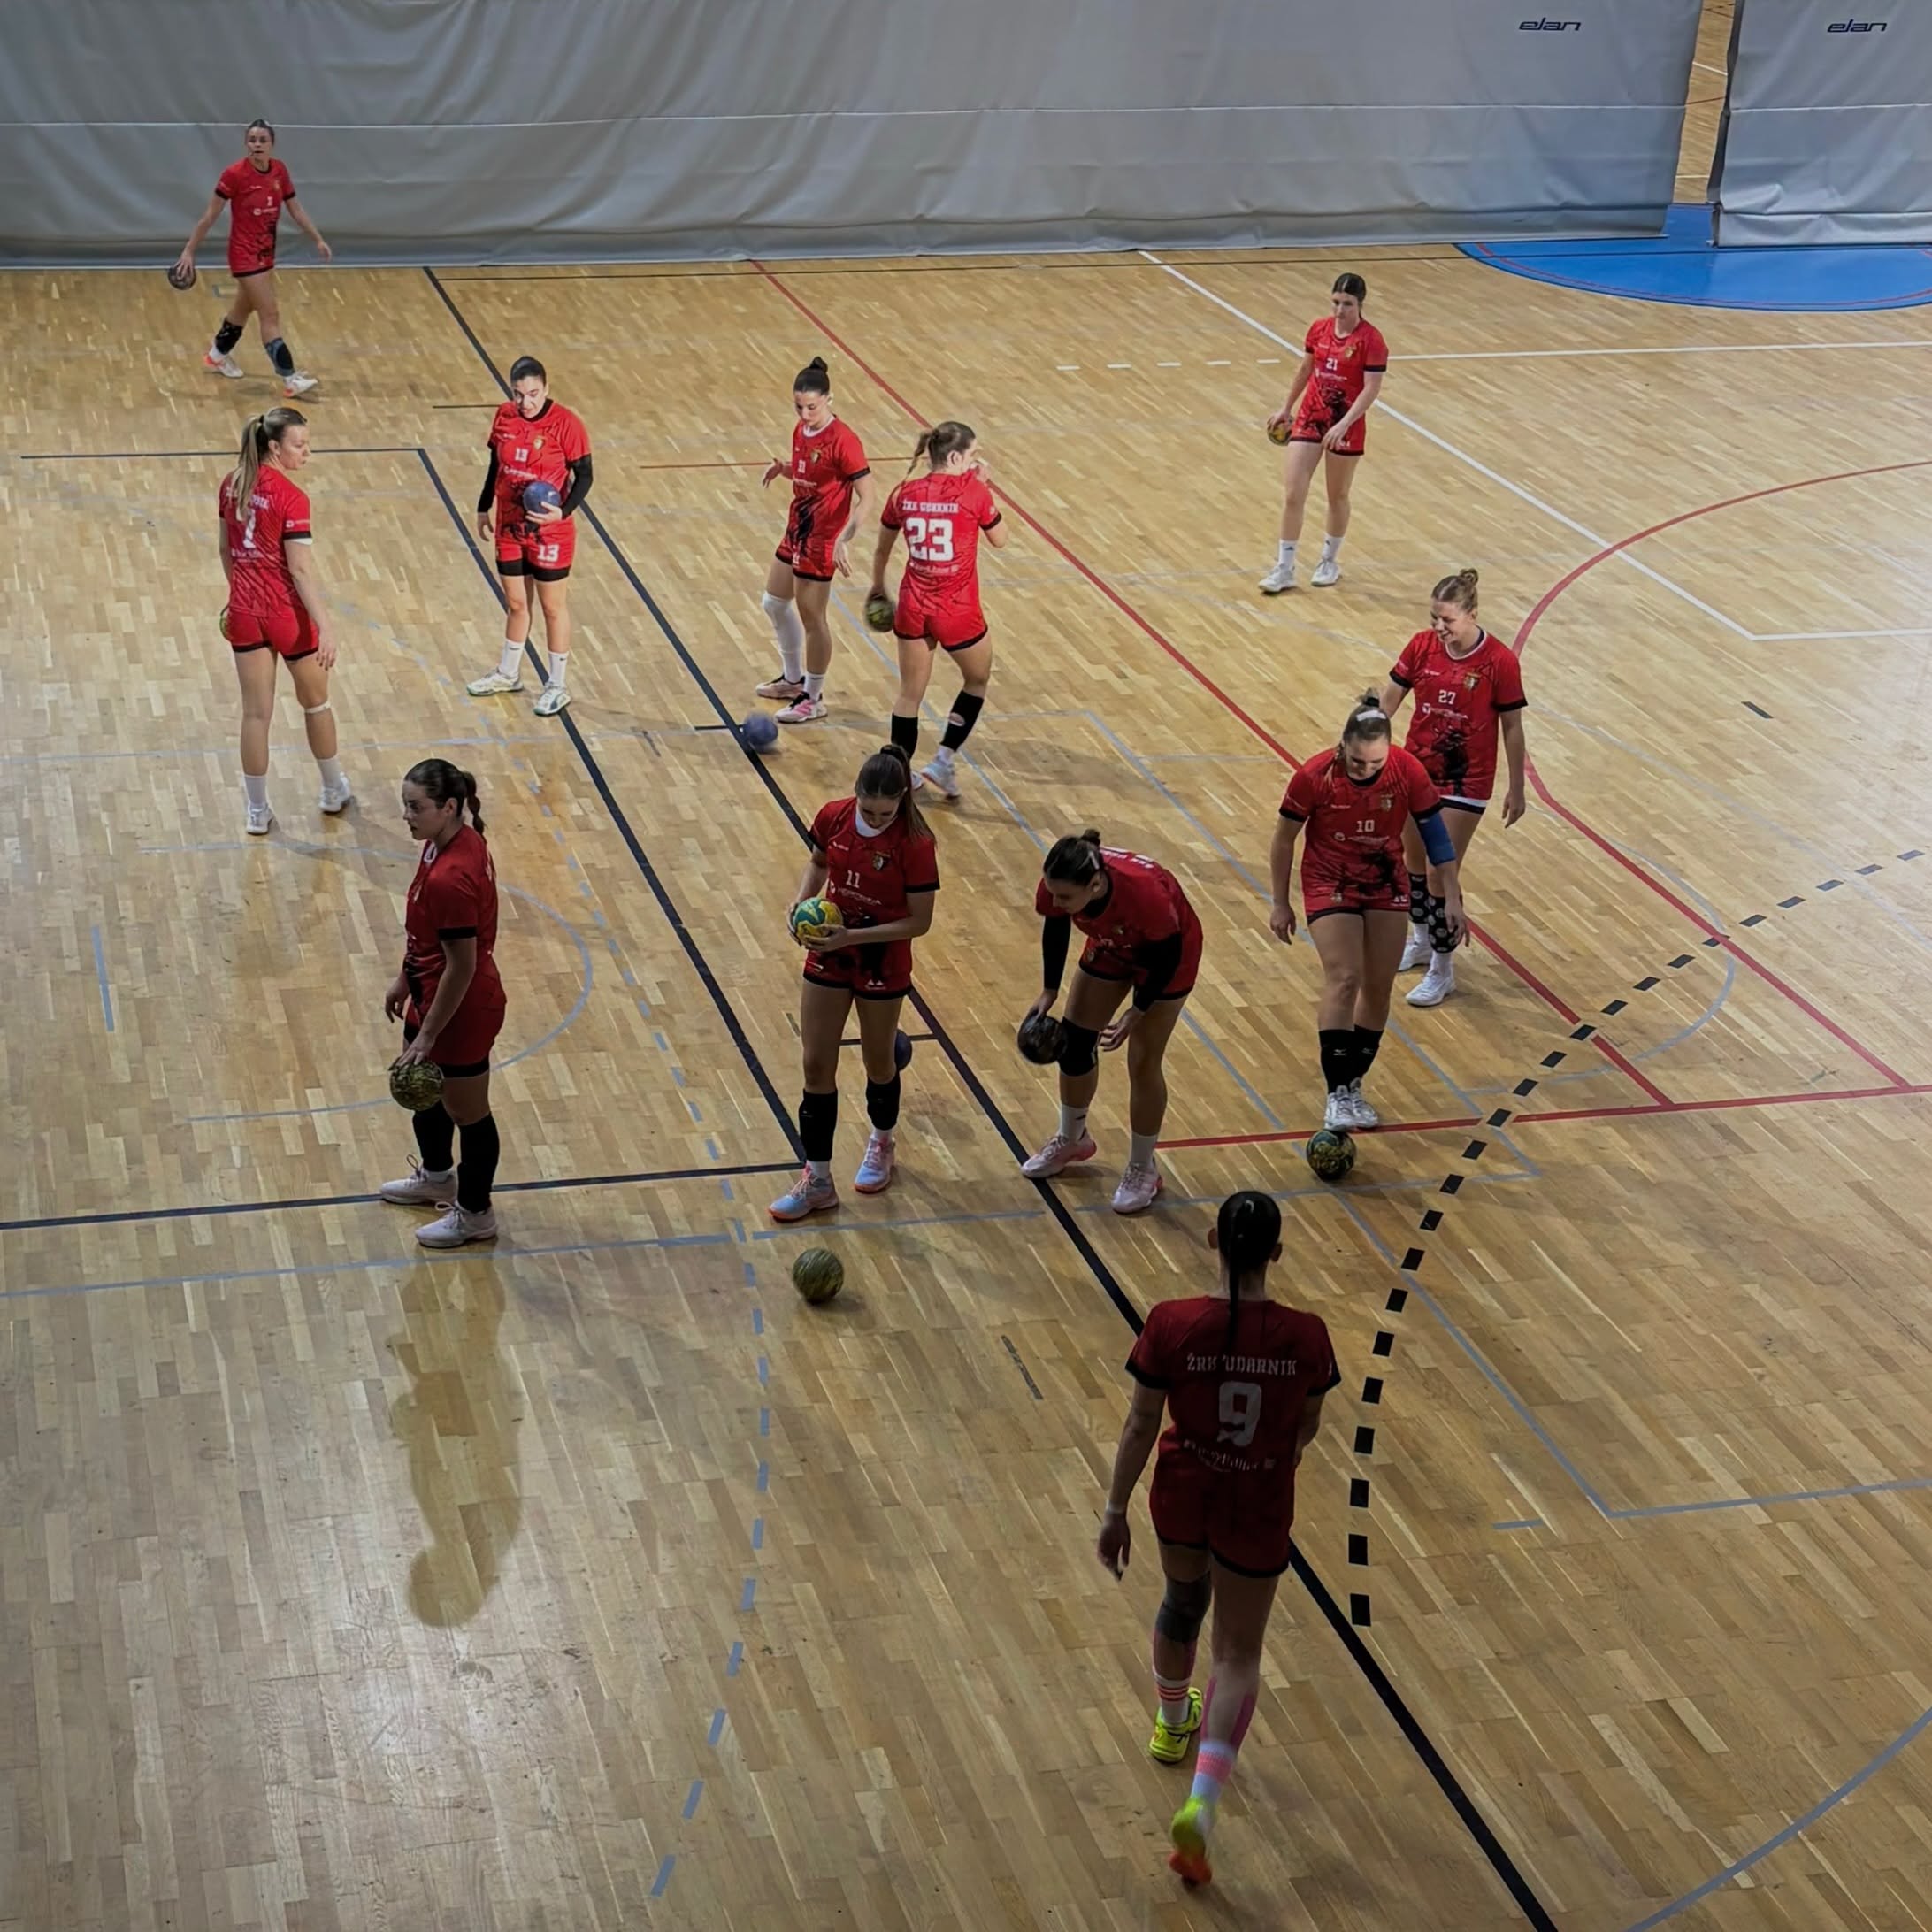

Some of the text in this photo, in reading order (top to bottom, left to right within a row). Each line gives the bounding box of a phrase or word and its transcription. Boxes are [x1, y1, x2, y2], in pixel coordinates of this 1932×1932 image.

[1518, 17, 1582, 32] elan
[1827, 19, 1888, 34] elan
[1326, 357, 1338, 371] 21
[515, 447, 529, 462] 13
[905, 517, 954, 561] 23
[537, 543, 560, 562] 13
[1438, 689, 1456, 705] 27
[1355, 819, 1376, 833] 10
[846, 870, 861, 889] 11
[1186, 1352, 1298, 1376] ŽRK UDARNIK
[1216, 1380, 1262, 1447] 9
